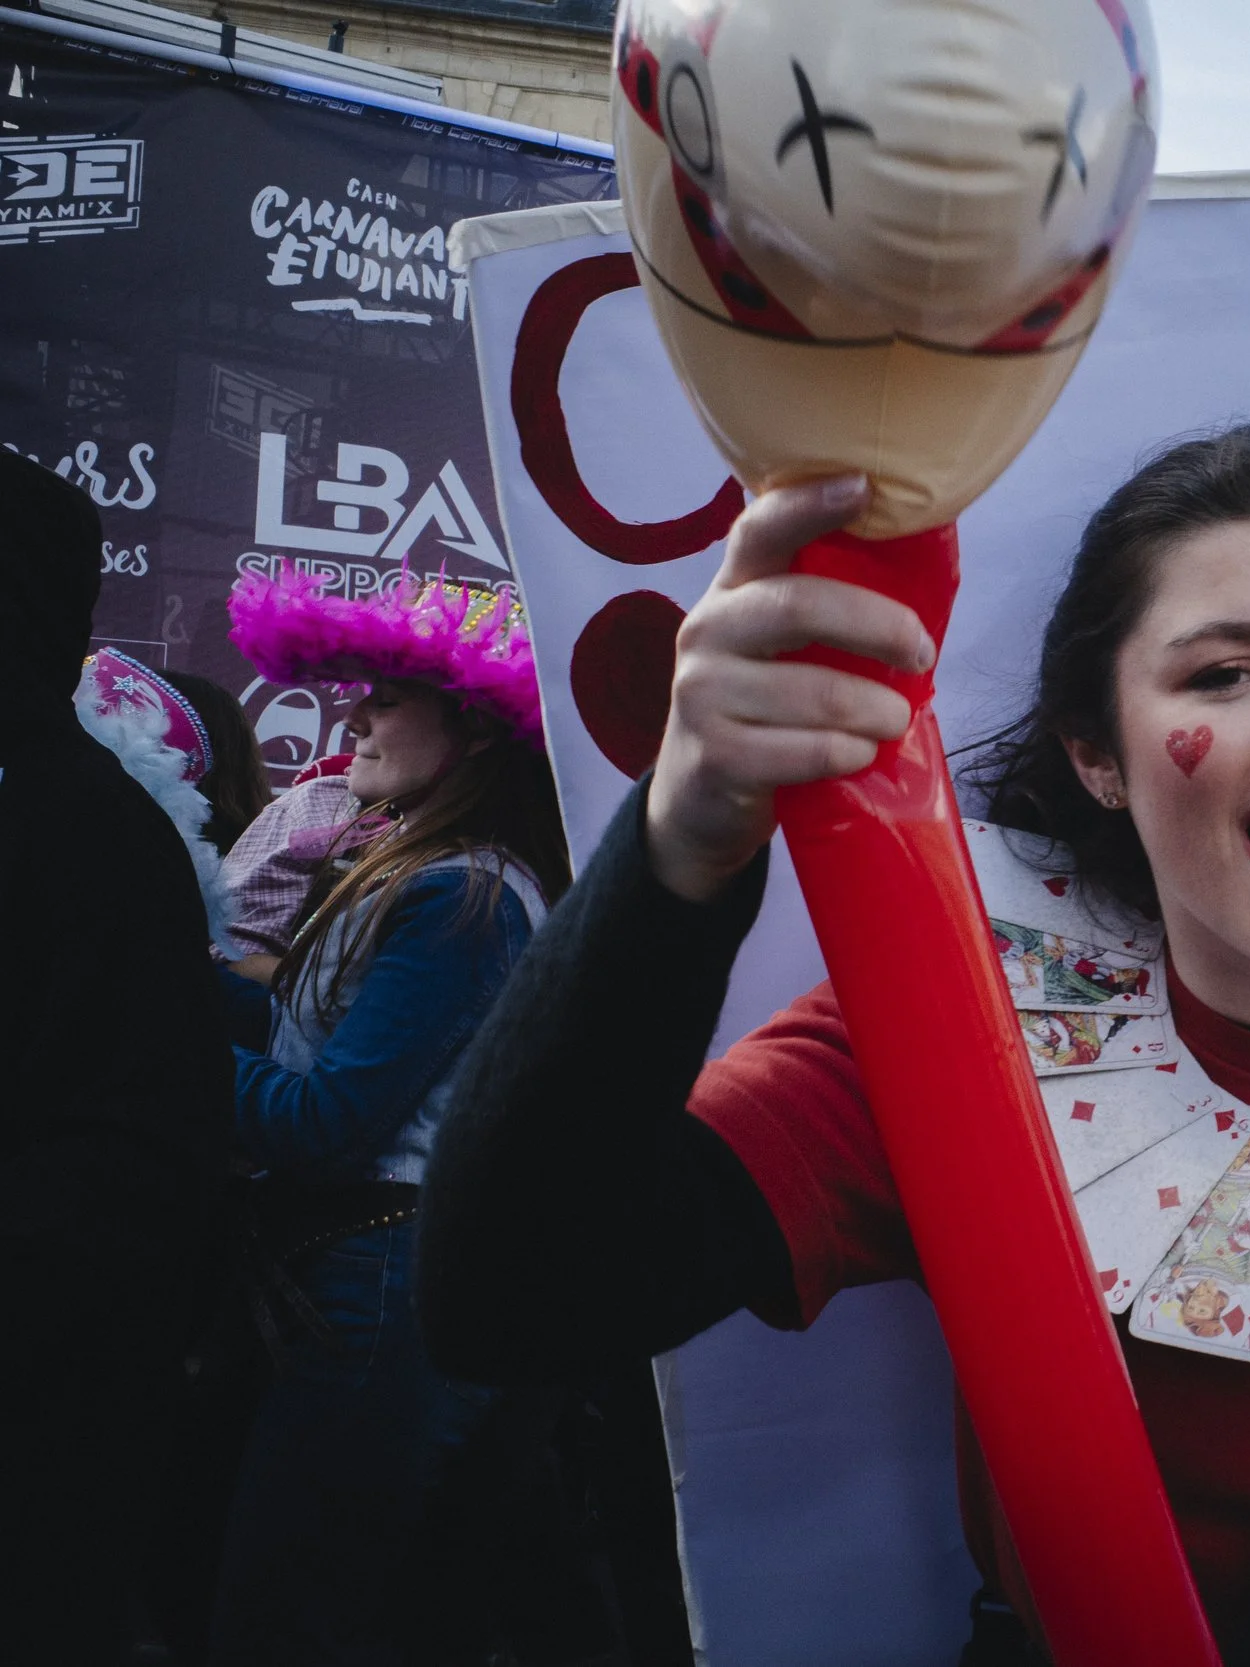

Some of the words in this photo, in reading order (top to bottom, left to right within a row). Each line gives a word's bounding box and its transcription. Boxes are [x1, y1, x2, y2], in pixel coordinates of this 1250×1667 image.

[285, 89, 365, 116] Carnaval
[411, 116, 444, 134] love
[448, 127, 521, 152] Carnaval
[346, 177, 398, 210] CAEN
[254, 431, 512, 572] LBA
